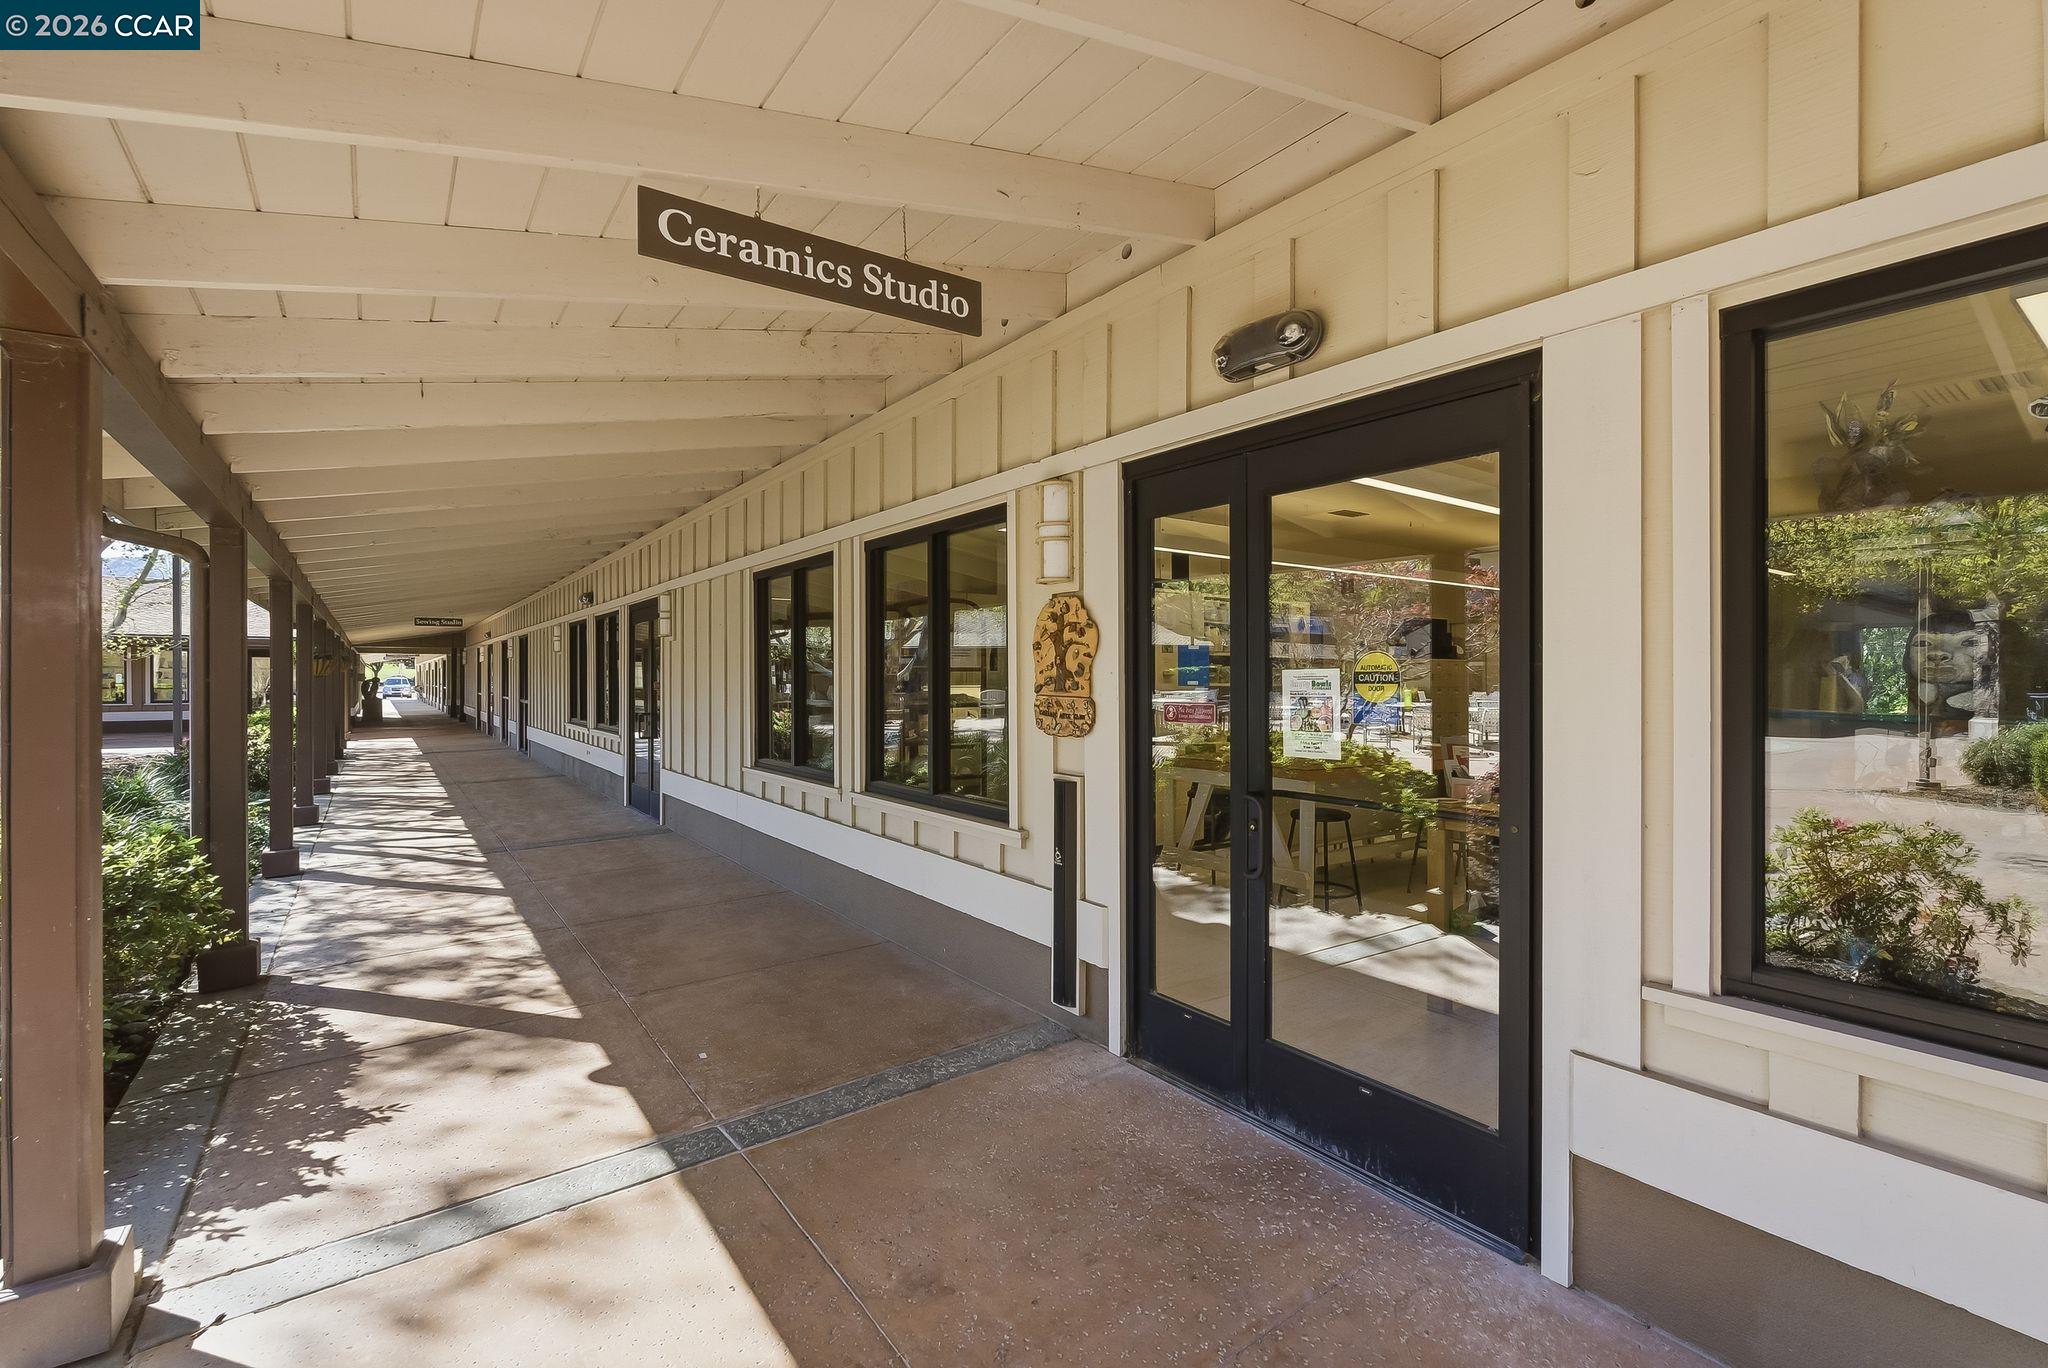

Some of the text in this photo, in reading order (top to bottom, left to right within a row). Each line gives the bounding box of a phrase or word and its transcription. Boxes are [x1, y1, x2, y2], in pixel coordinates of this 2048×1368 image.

[657, 208, 969, 318] Ceramics Studio
[1358, 674, 1395, 682] CAUTION
